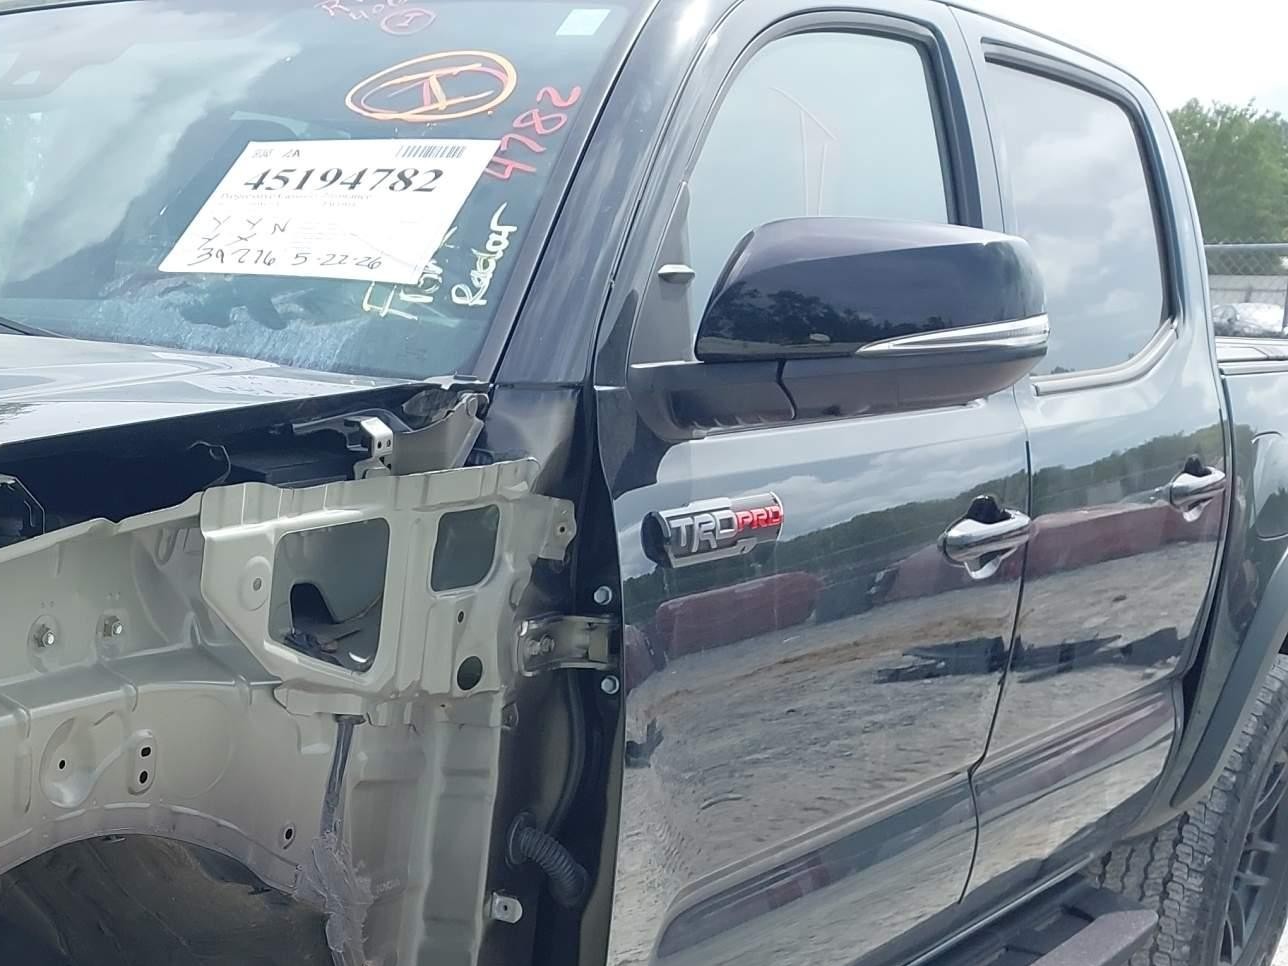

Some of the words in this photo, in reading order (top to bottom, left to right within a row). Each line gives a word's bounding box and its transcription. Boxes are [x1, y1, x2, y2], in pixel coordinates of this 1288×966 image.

[485, 86, 582, 180] 4782
[243, 167, 444, 193] 45194782
[451, 202, 518, 307] Radar
[669, 509, 737, 553] TRD
